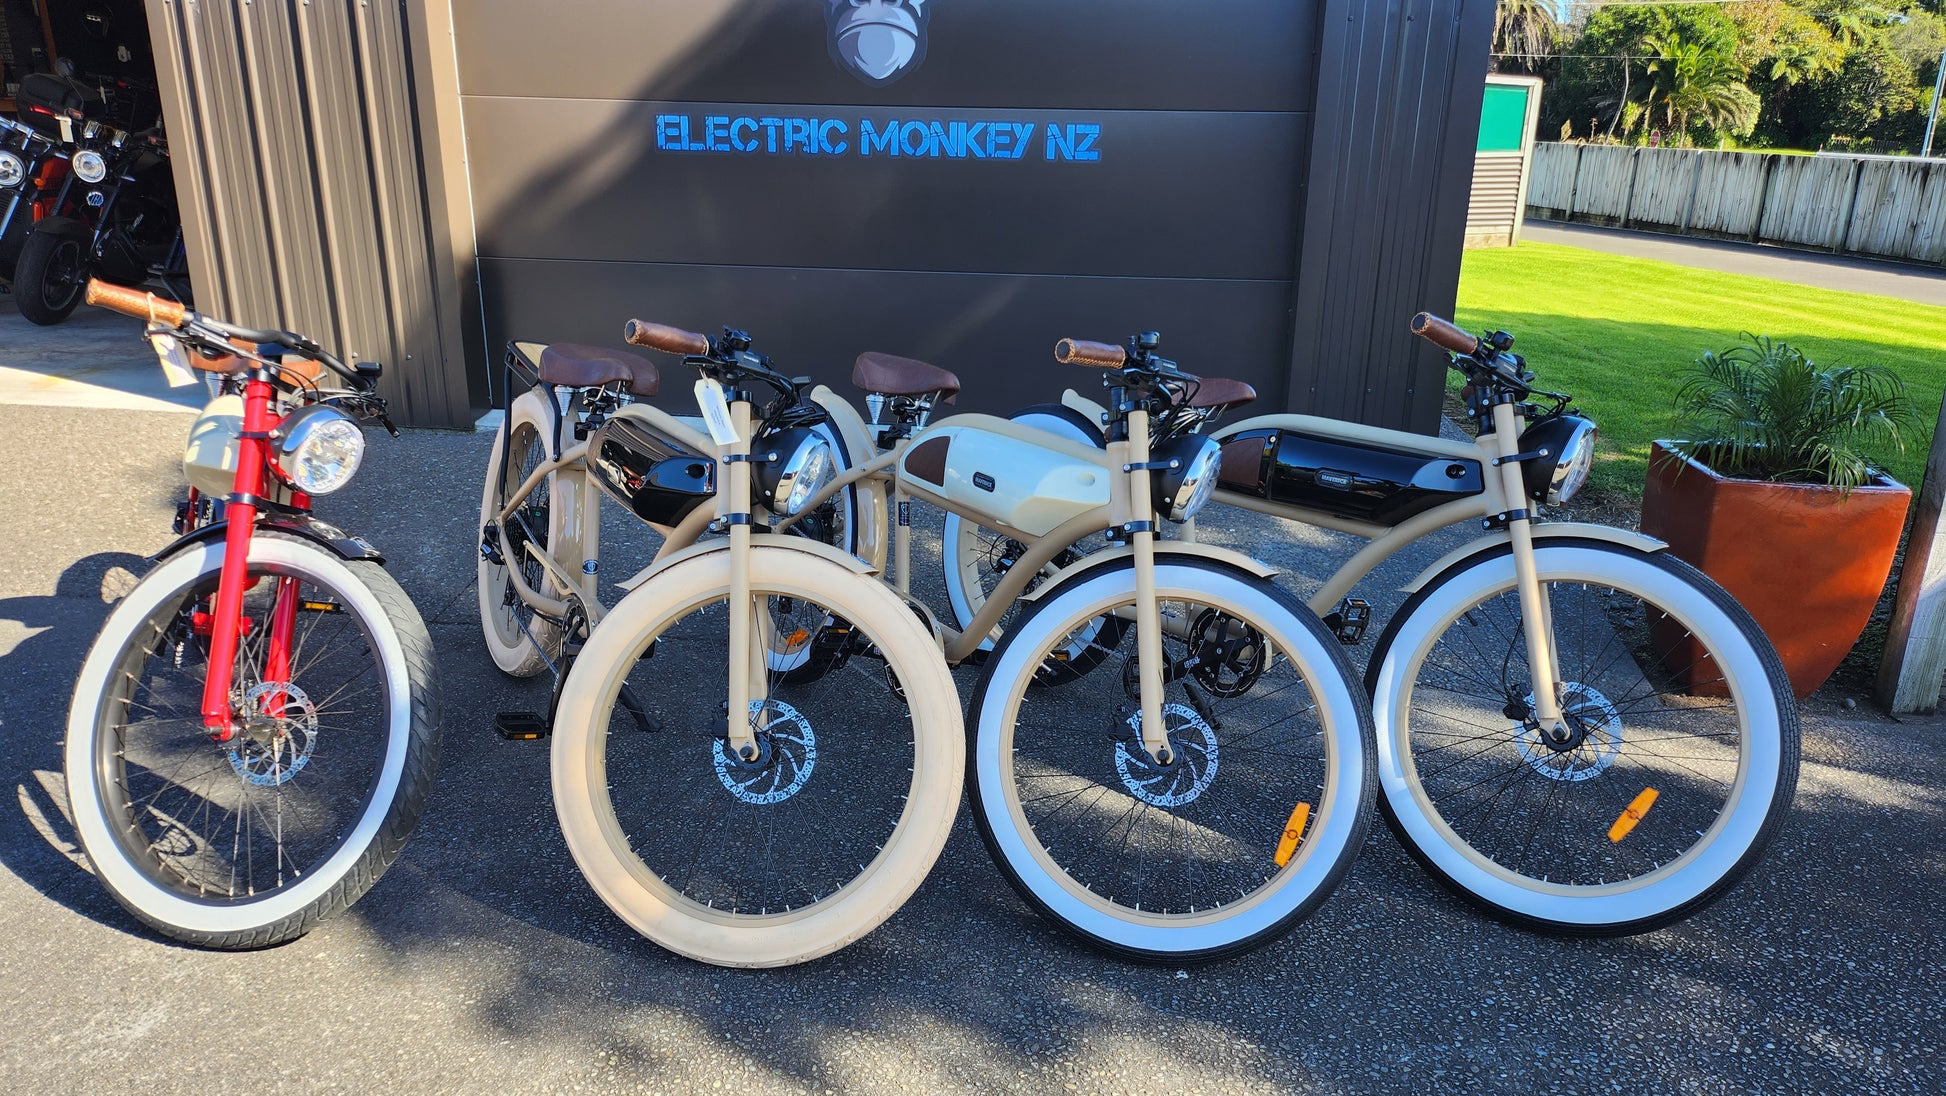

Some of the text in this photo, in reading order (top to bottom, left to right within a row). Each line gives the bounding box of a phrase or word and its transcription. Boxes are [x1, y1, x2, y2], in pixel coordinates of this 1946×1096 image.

[655, 114, 1100, 161] ELECTRIC MONKEY NZ
